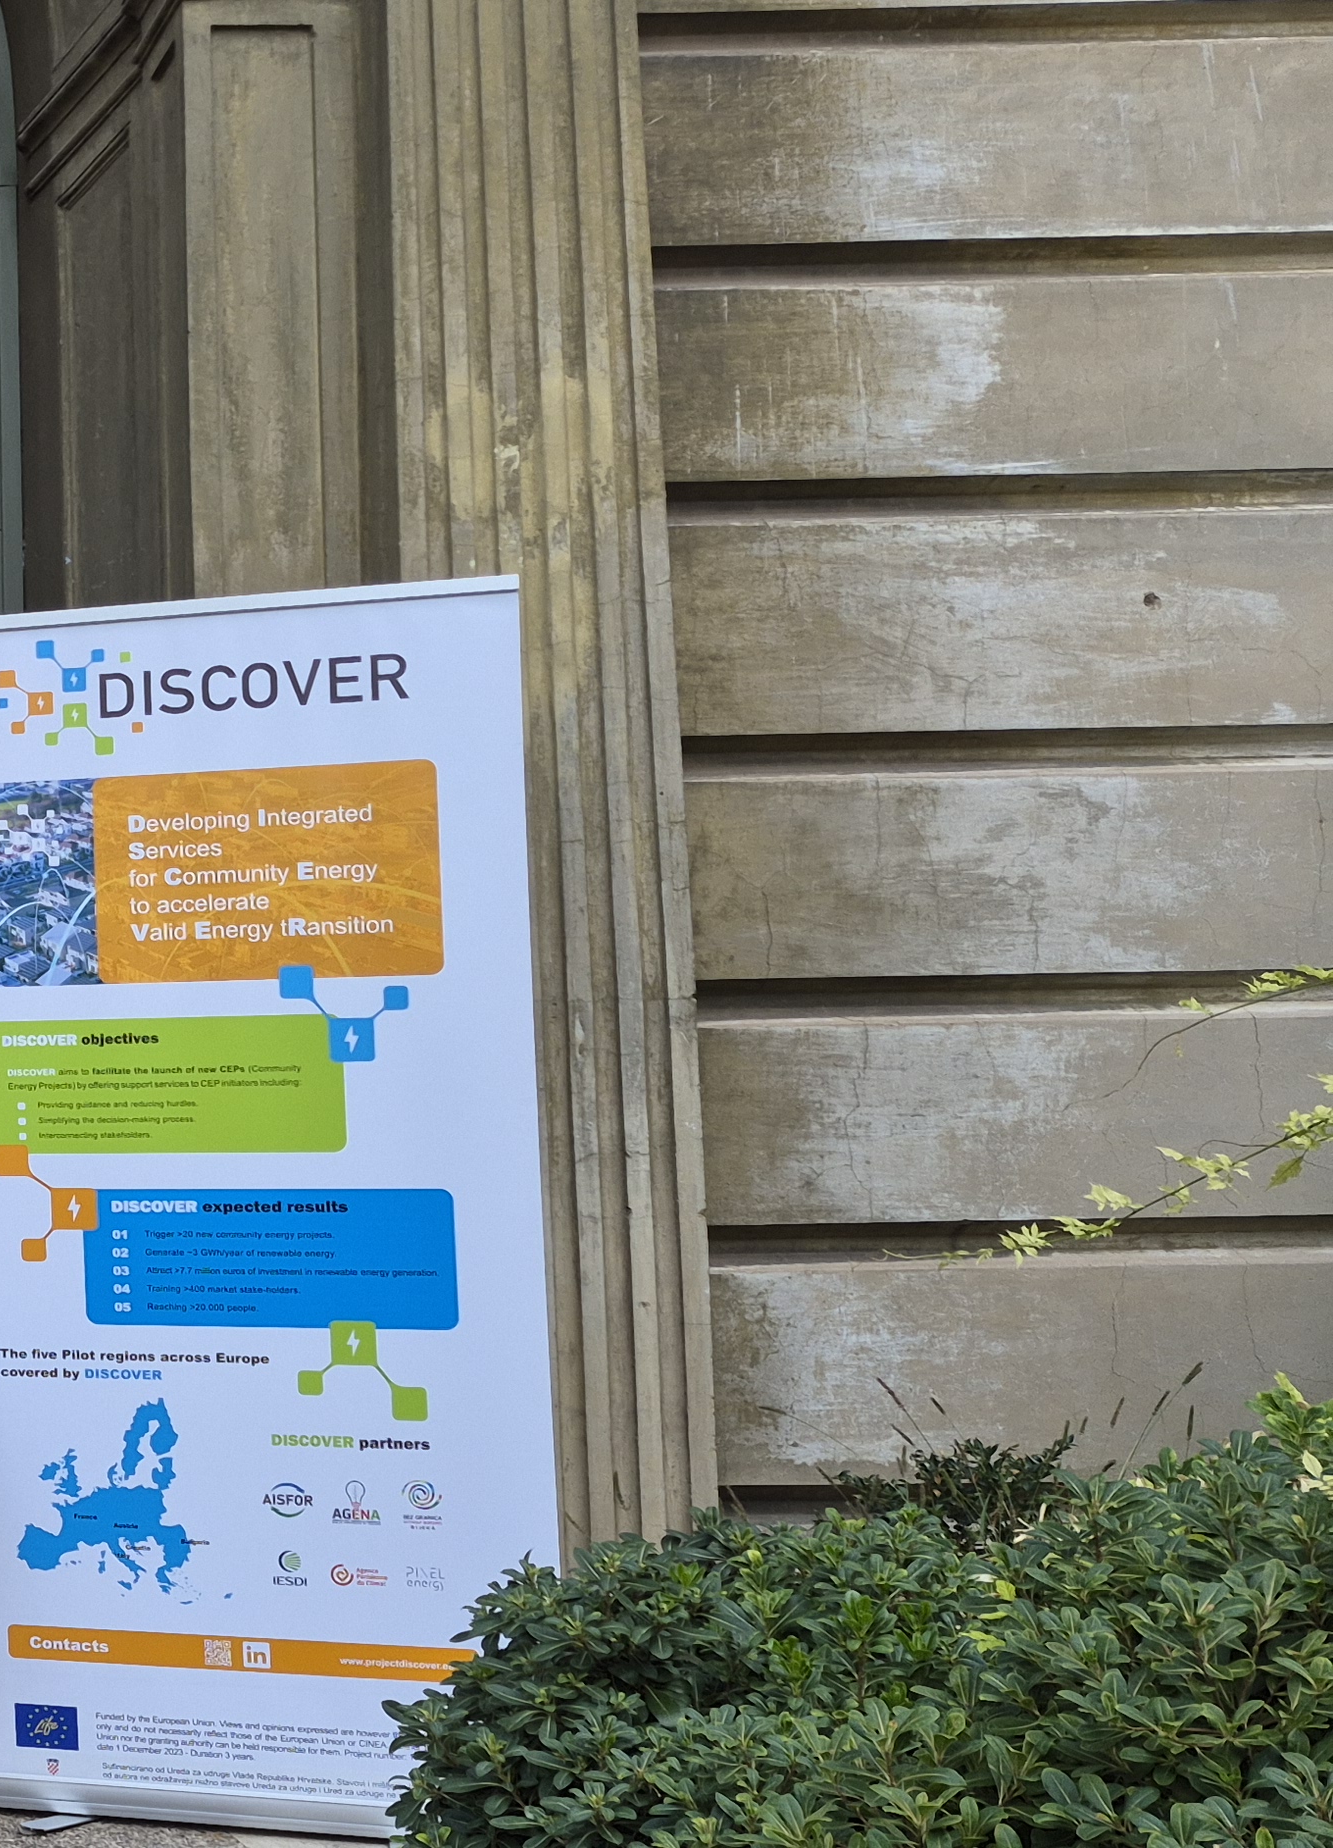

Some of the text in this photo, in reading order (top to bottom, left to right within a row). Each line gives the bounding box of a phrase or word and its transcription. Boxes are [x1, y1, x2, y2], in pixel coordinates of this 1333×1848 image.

[99, 653, 410, 719] DISCOVER
[127, 803, 372, 833] Developing Integrated
[128, 840, 222, 860] Services
[129, 861, 377, 887] for Community Energy
[130, 893, 269, 914] to accelerate
[131, 916, 394, 943] Valid Energy tRansition
[1, 1033, 159, 1047] DISCOVER objectives
[7, 1068, 56, 1077] DISCOVER
[58, 1068, 78, 1076] aims
[81, 1068, 89, 1076] to
[92, 1067, 131, 1075] facilitate
[134, 1067, 148, 1075] the
[151, 1066, 182, 1074] launch
[185, 1066, 195, 1074] of
[219, 1065, 245, 1073] CEPs
[7, 1082, 37, 1091] Energy
[38, 1082, 75, 1091] Projects)
[77, 1081, 86, 1090] by
[88, 1081, 119, 1090] offering
[121, 1081, 153, 1090] support
[37, 1101, 73, 1110] Providing
[76, 1101, 110, 1109] guidance
[130, 1100, 164, 1109] reducing
[38, 1116, 80, 1125] Simplifying
[82, 1116, 95, 1124] the
[97, 1116, 160, 1124] decision-making
[111, 1200, 348, 1215] DISCOVER expected results
[111, 1229, 128, 1240] 01
[145, 1230, 174, 1239] Trigger
[216, 1231, 261, 1240] community
[265, 1232, 294, 1240] energy
[297, 1231, 335, 1240] projects.
[111, 1248, 129, 1258] 02
[145, 1248, 184, 1256] Generate
[201, 1249, 243, 1258] GWh/year
[246, 1249, 255, 1257] of
[257, 1249, 302, 1257] renewable
[305, 1251, 337, 1259] energy.
[113, 1266, 130, 1276] 03
[195, 1267, 220, 1275] million
[360, 1270, 390, 1278] energy
[113, 1284, 131, 1294] 04
[146, 1285, 181, 1294] Training
[114, 1302, 131, 1312] 05
[147, 1303, 187, 1312] Reaching
[227, 1305, 259, 1313] people.
[0, 1348, 270, 1367] The five Pilot regions across Europe
[0, 1367, 162, 1381] covered by DISCOVER
[271, 1434, 431, 1451] DISCOVER partners
[262, 1494, 313, 1507] AISFOR
[332, 1508, 381, 1520] AGENA
[272, 1576, 308, 1586] IESDI
[29, 1636, 109, 1654] Contacts
[246, 1645, 267, 1664] in
[95, 1712, 124, 1721] Funded
[127, 1714, 136, 1723] by
[152, 1716, 190, 1726] European
[297, 1726, 338, 1736] expressed
[356, 1730, 391, 1738] however
[96, 1723, 112, 1731] only
[114, 1724, 128, 1732] and
[230, 1732, 252, 1740] those
[280, 1735, 319, 1745] European
[321, 1738, 345, 1746] Union
[96, 1733, 118, 1741] Union
[135, 1735, 146, 1743] the
[148, 1737, 179, 1747] granting
